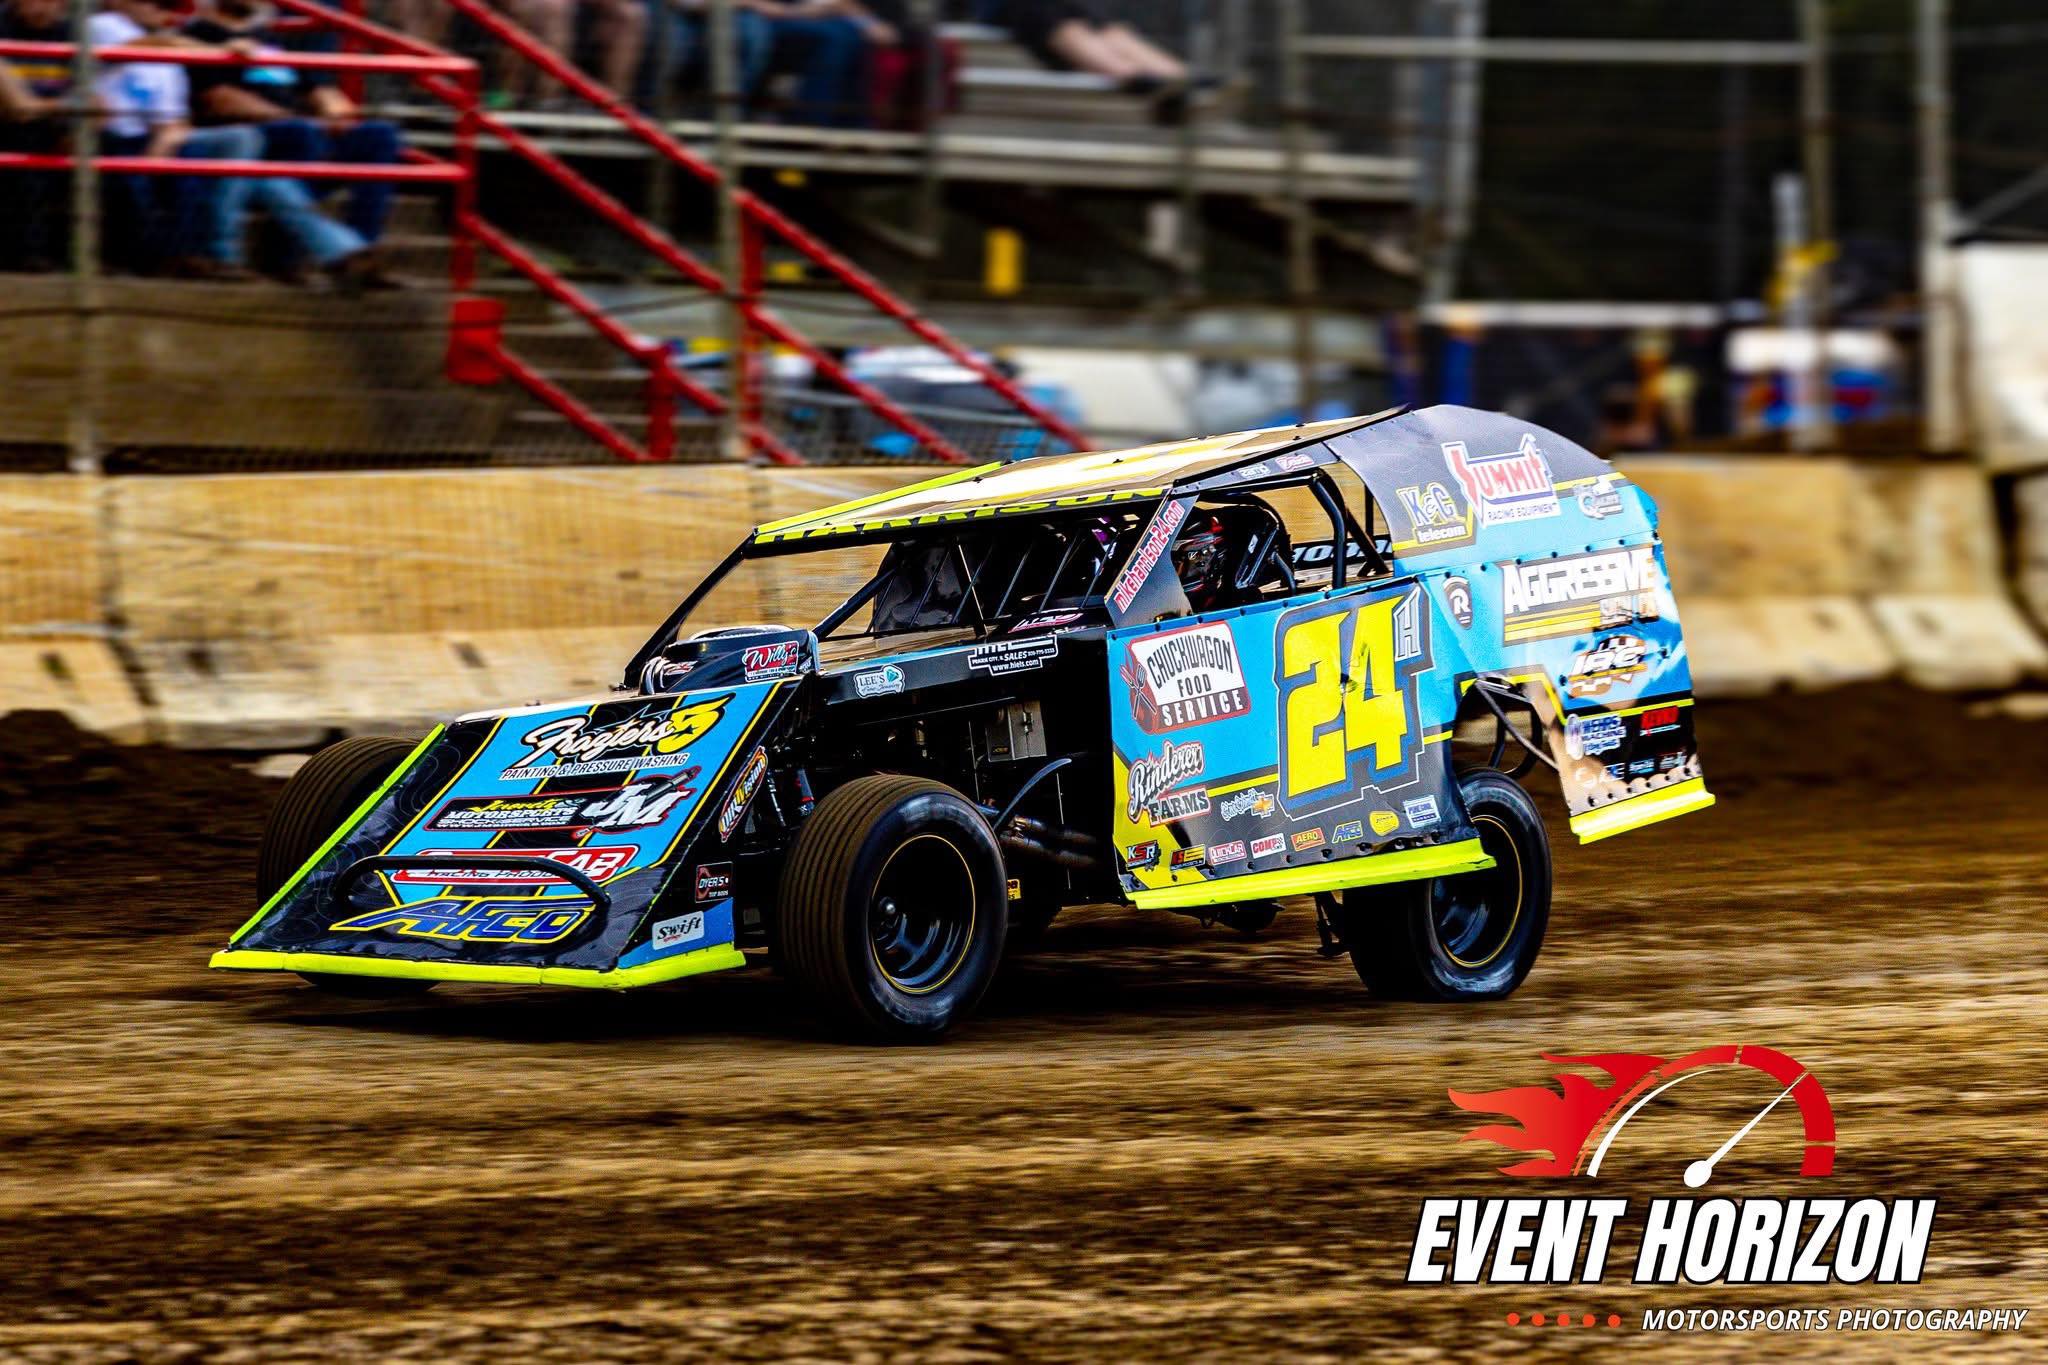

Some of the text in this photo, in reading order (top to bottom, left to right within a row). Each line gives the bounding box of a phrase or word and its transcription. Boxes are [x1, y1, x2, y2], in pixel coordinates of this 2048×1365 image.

[1417, 525, 1466, 543] telecom
[742, 643, 797, 670] Willy's
[1004, 651, 1028, 661] SALES
[1146, 634, 1234, 689] CHUCKWAGON
[859, 674, 885, 687] LEE'S
[1177, 673, 1212, 697] FOOD
[1283, 594, 1408, 798] 24
[1161, 689, 1244, 727] SERVICE
[502, 753, 689, 780] PAINTING & PRESSURE WASHING
[446, 807, 578, 819] MOTORSPORTS
[1150, 789, 1209, 823] FARMS
[1296, 832, 1318, 844] AERO
[1127, 843, 1156, 860] KSR
[657, 917, 702, 940] Swift
